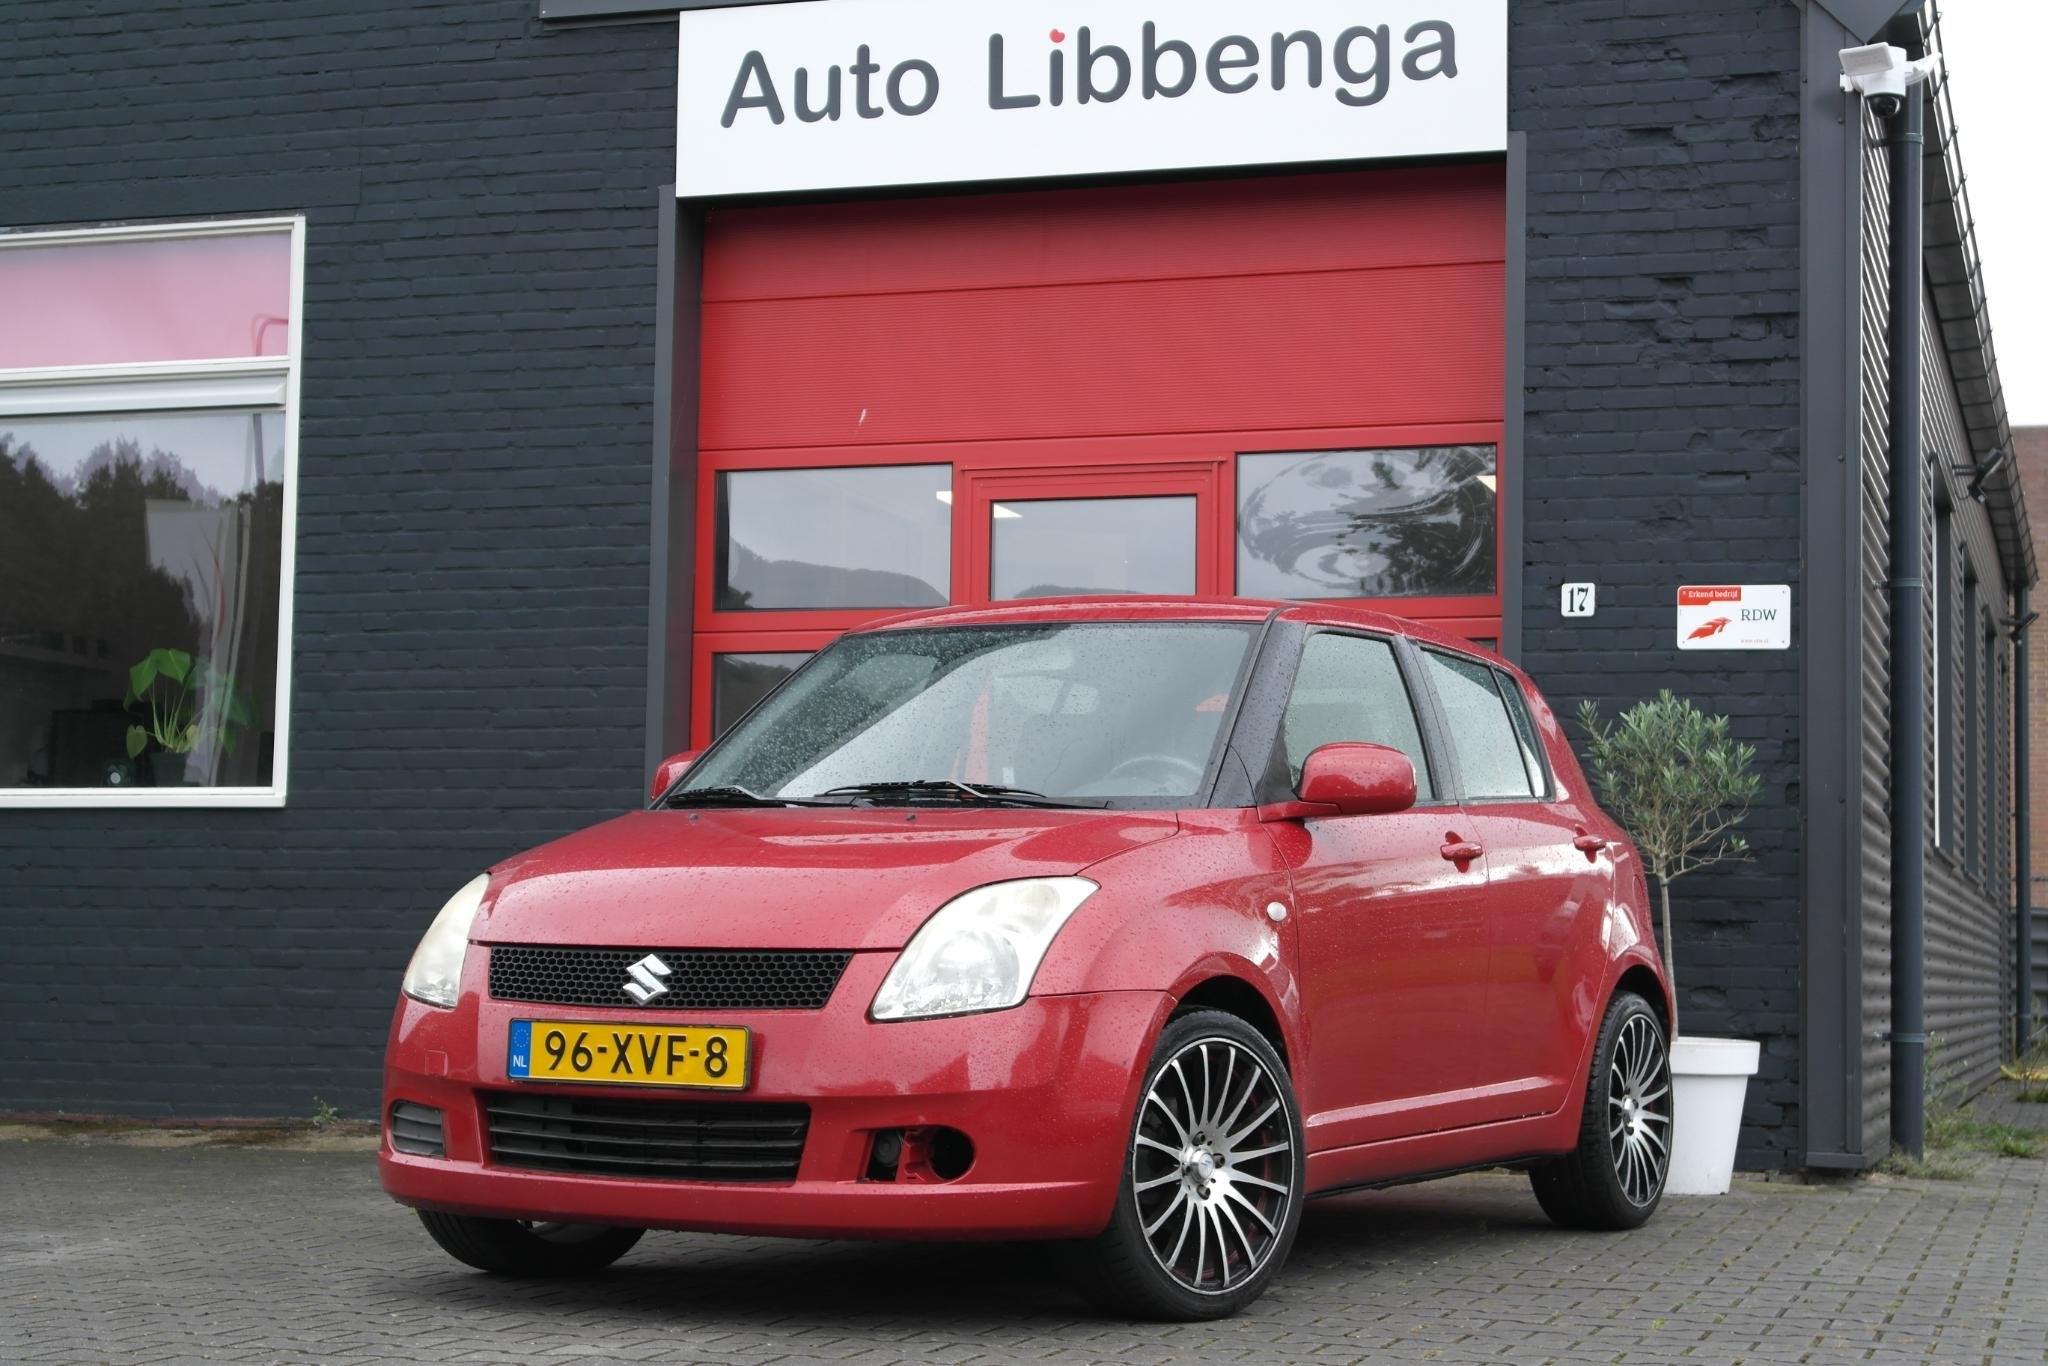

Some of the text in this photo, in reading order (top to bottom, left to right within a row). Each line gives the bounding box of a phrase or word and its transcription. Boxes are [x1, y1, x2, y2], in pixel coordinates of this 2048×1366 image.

[720, 19, 1459, 128] Auto Libbenga
[1567, 586, 1589, 613] 17
[1688, 590, 1714, 598] Erkend
[1740, 608, 1777, 621] RDW
[513, 1055, 527, 1068] NL
[544, 1030, 729, 1078] 96-XVF-8
